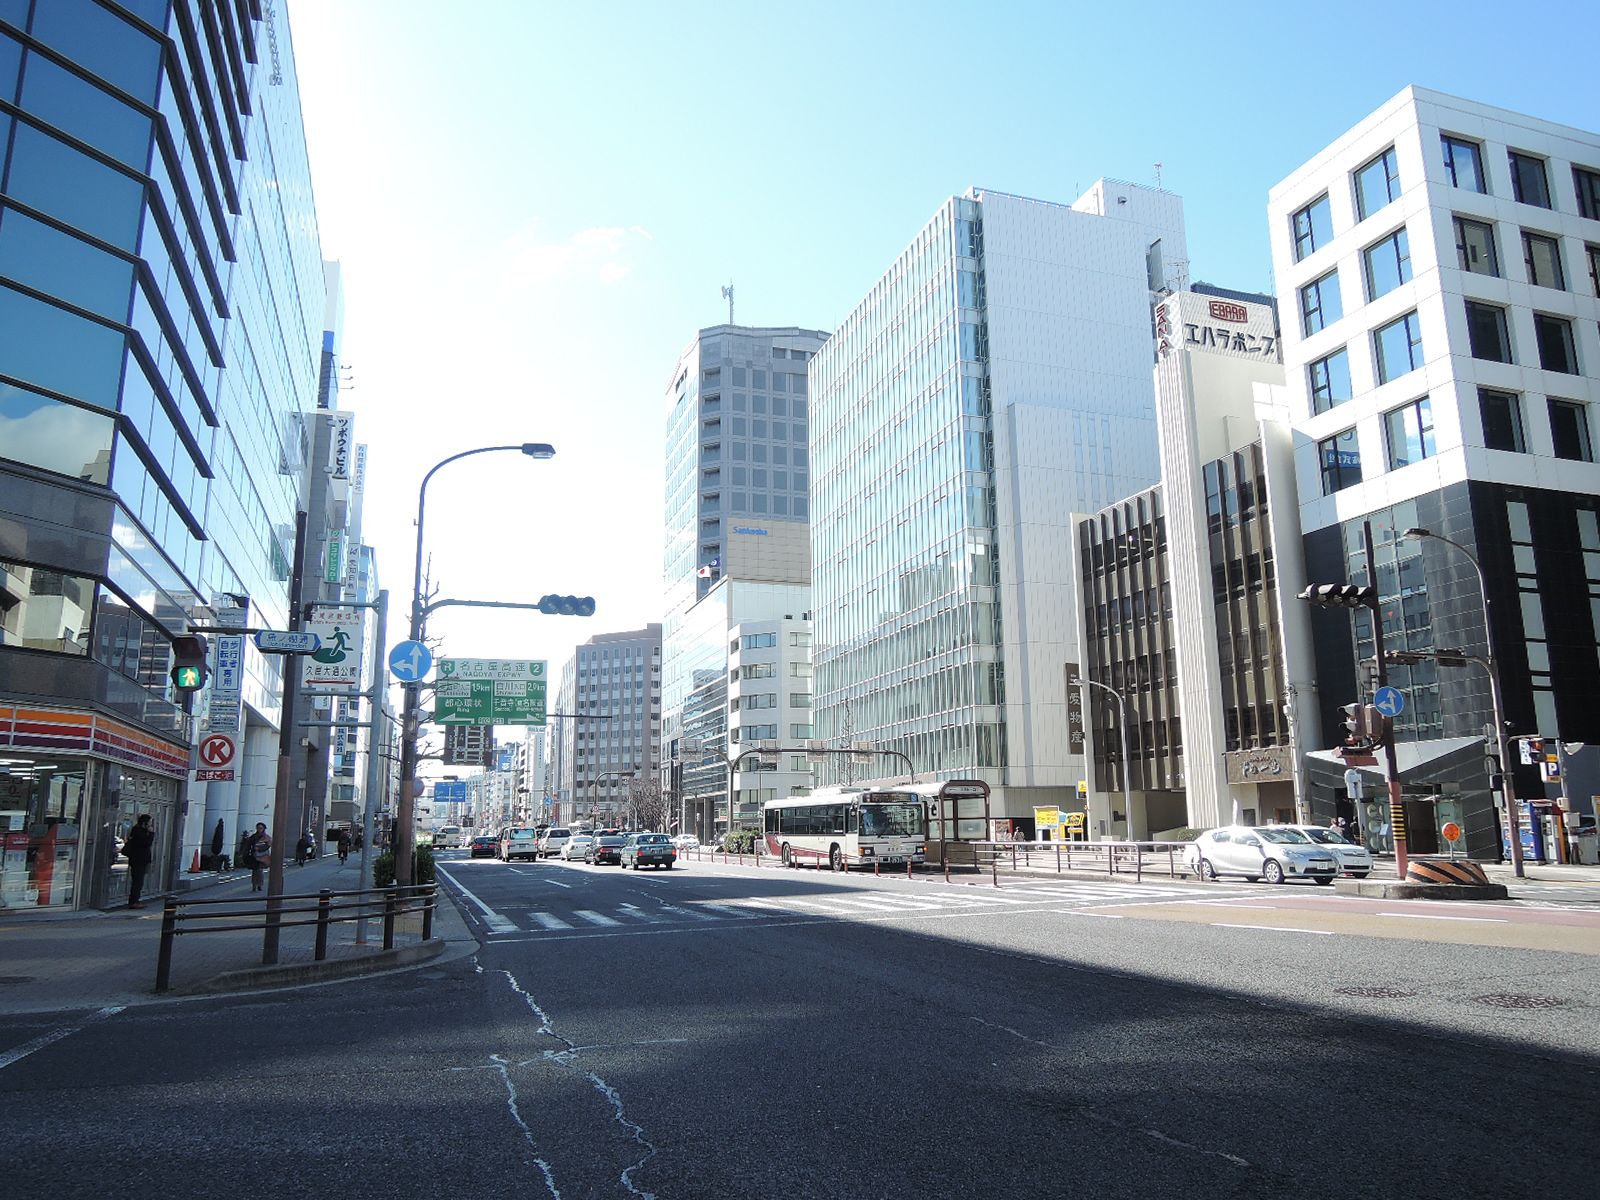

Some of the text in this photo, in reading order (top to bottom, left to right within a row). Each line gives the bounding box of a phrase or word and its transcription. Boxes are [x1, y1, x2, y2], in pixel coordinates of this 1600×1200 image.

[1211, 303, 1246, 321] EBARA
[1184, 323, 1275, 356] エハラポンプ
[334, 417, 348, 475] ツボウチビル
[460, 661, 526, 672] 名古屋高速
[533, 664, 540, 673] 2
[1547, 762, 1558, 775] P
